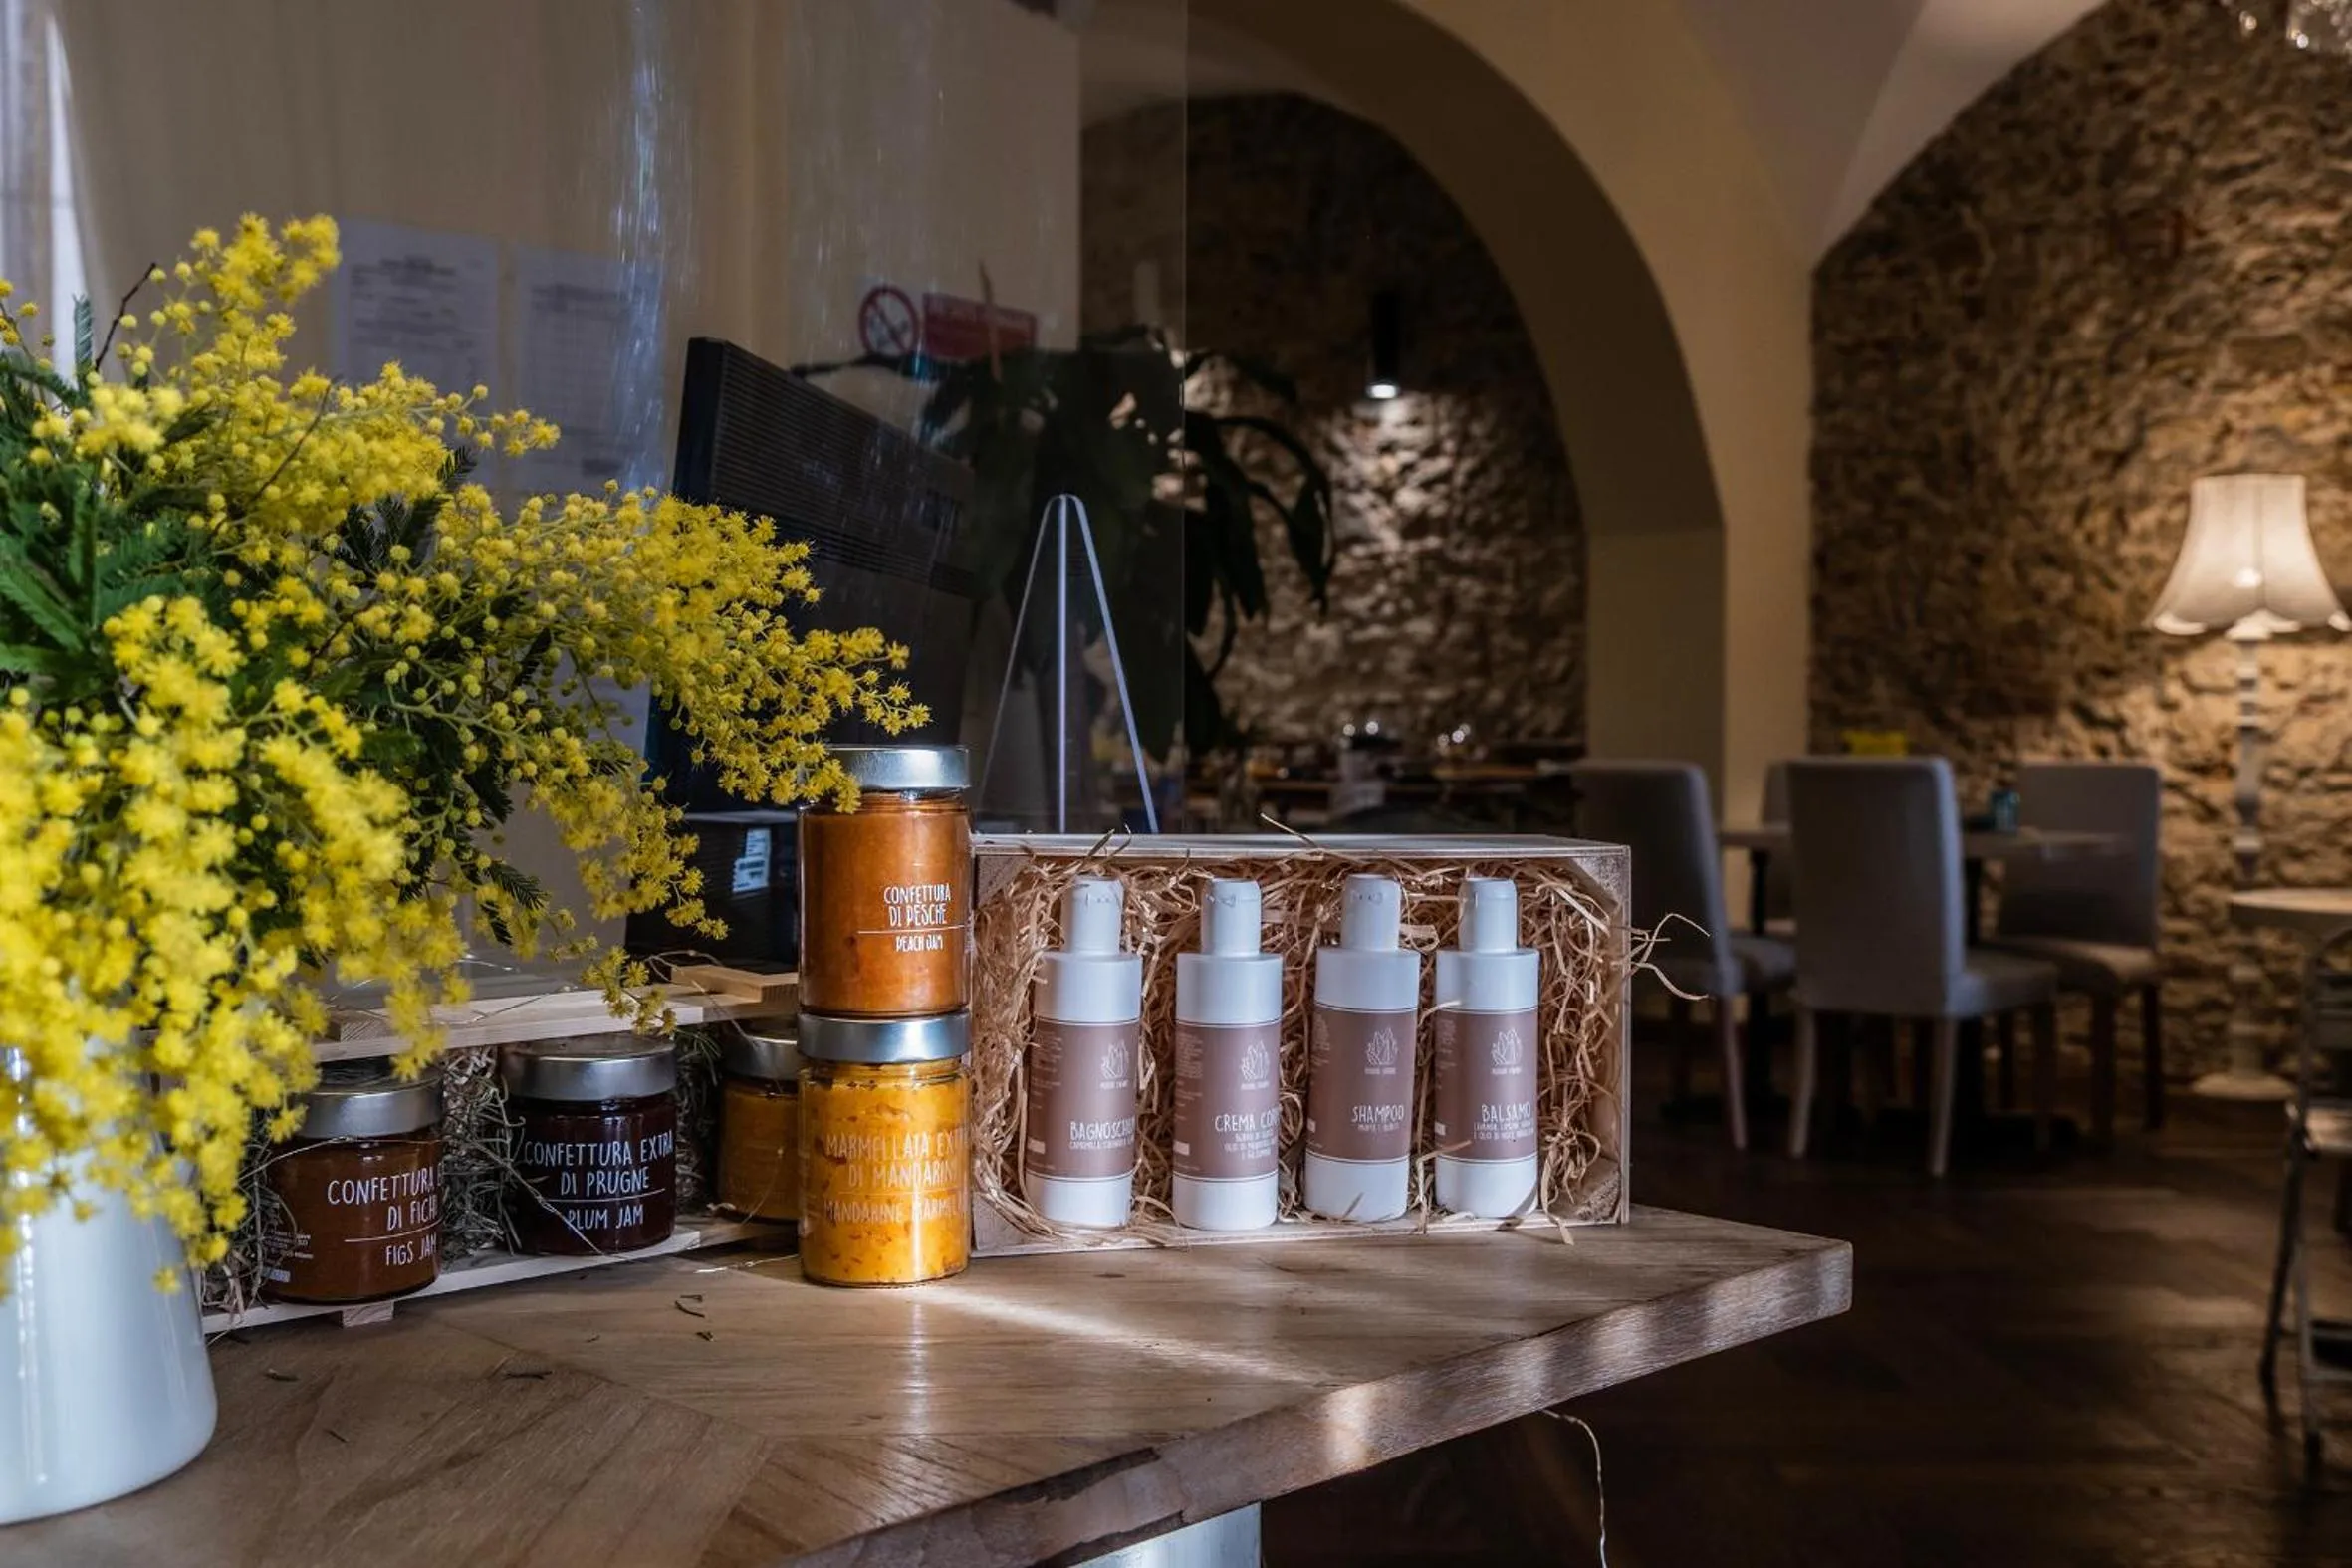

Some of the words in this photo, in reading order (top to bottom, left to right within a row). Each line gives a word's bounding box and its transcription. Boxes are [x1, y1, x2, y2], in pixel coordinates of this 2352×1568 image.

[883, 882, 951, 904] CONFETTURA
[889, 905, 901, 927] DI
[907, 903, 948, 926] PESCHE
[895, 935, 925, 952] PEACH
[926, 933, 944, 952] JAM
[1214, 1113, 1256, 1133] CREMA
[1350, 1104, 1405, 1124] SHAMPOO
[1481, 1101, 1531, 1123] BALSAMO
[524, 1140, 633, 1167] CONFETTURA
[825, 1130, 930, 1160] MARMELLATA
[561, 1172, 577, 1195] DI
[586, 1166, 650, 1197] PRUGNE
[847, 1164, 863, 1188] DI
[386, 1205, 402, 1232] DI
[568, 1208, 609, 1231] PLUM
[615, 1203, 645, 1229] JAM
[824, 1198, 904, 1225] MANDARINE
[385, 1240, 414, 1267] FIGS
